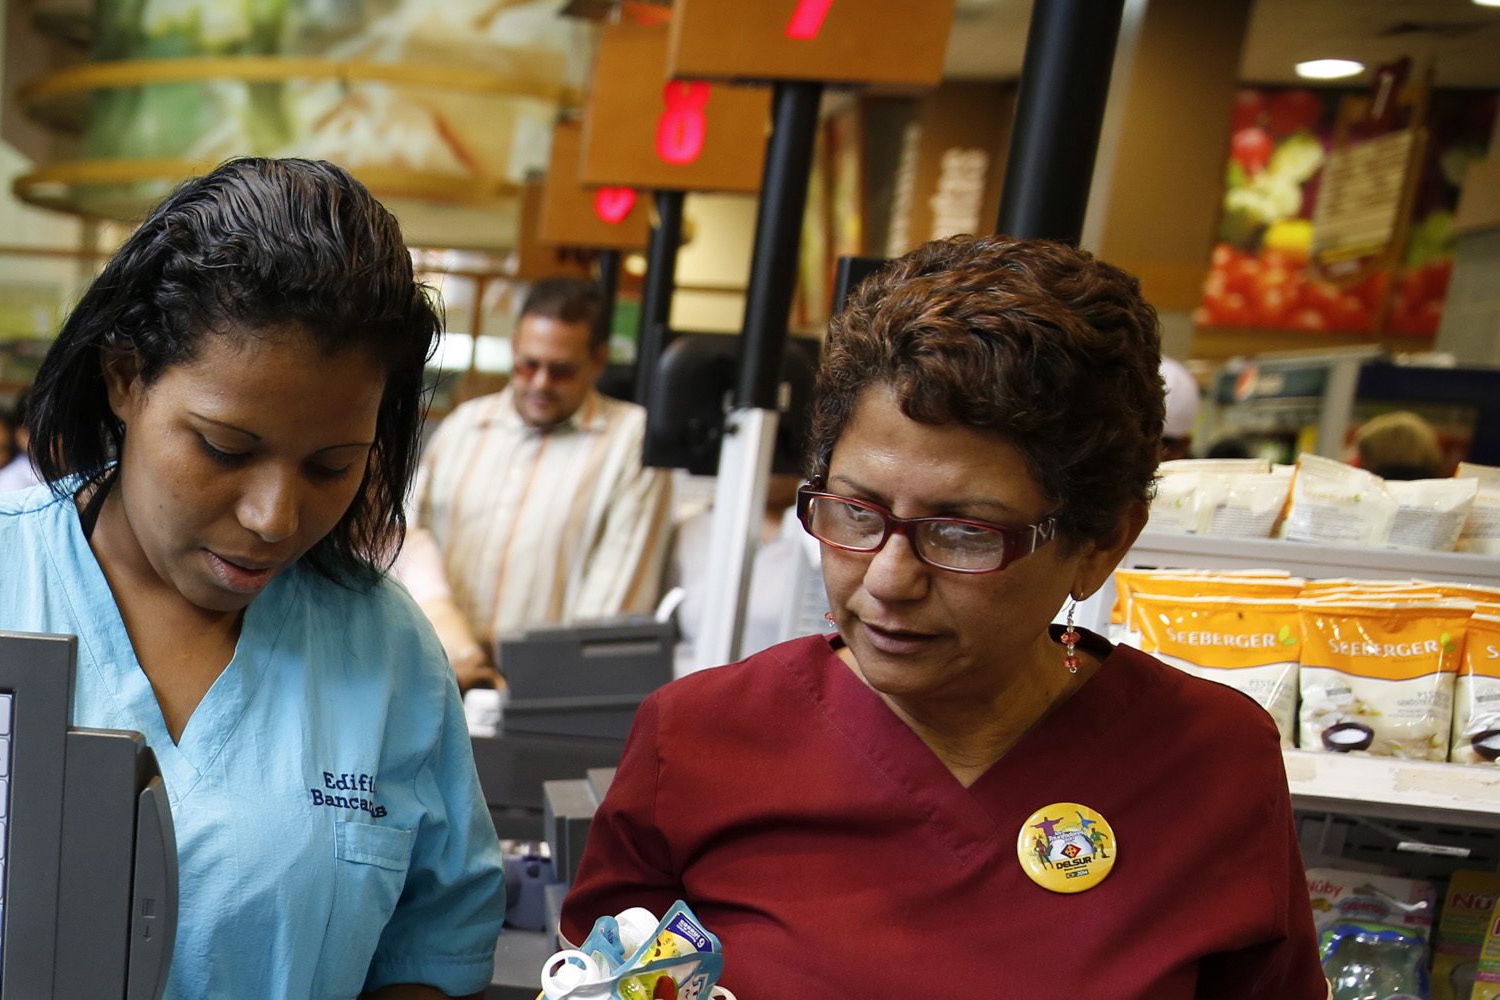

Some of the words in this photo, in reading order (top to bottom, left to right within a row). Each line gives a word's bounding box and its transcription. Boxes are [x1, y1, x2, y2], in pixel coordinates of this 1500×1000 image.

[1165, 627, 1275, 648] SEEBERGER
[1056, 856, 1092, 870] DELSUR
[696, 936, 706, 949] 6
